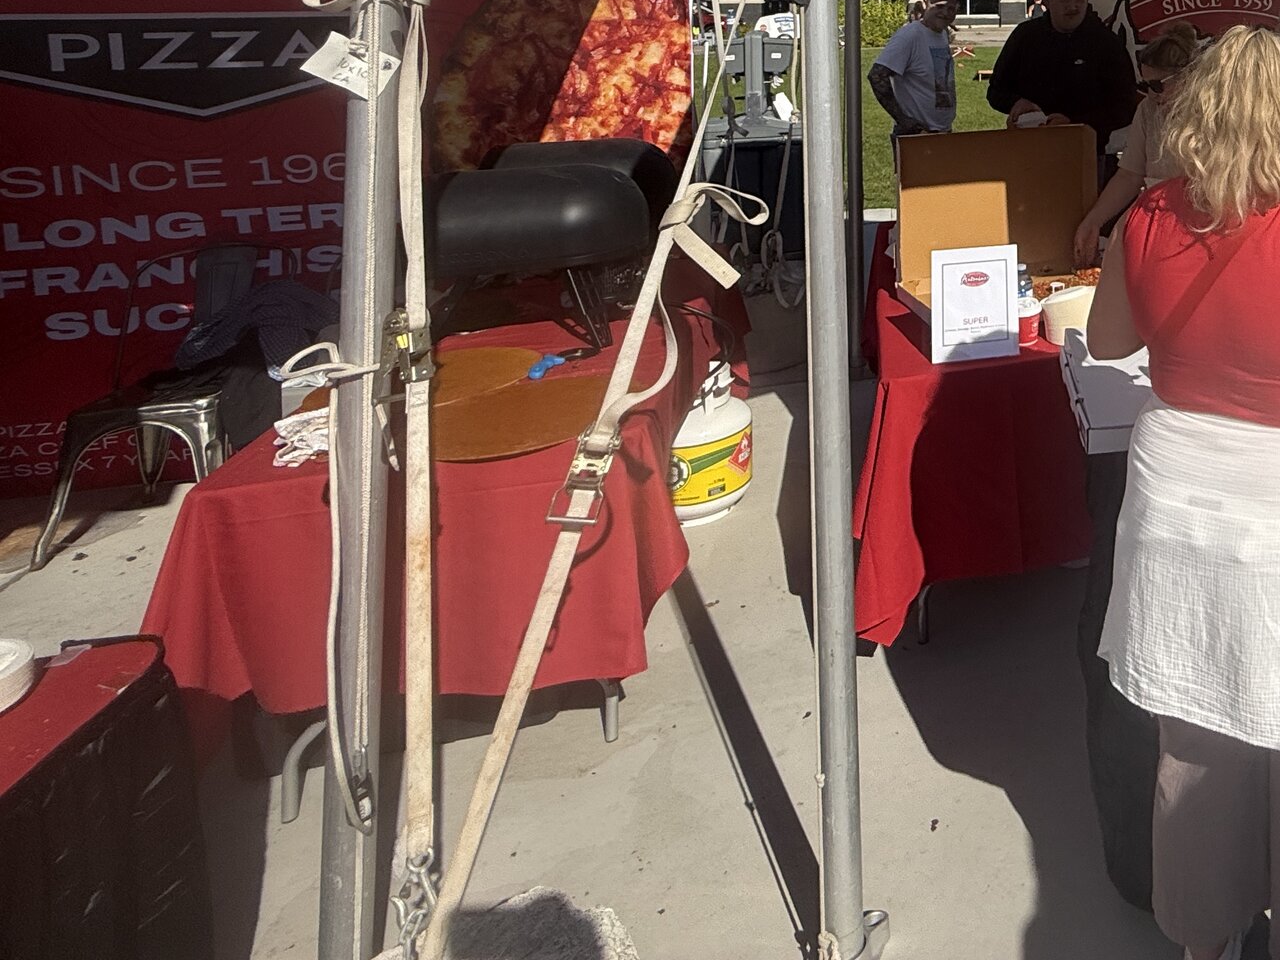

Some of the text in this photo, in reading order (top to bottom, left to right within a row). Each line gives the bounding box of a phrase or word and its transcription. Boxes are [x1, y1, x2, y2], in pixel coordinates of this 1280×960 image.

[47, 30, 322, 72] PIZZA
[0, 158, 227, 198] SINCE
[3, 202, 344, 252] LONG TER
[962, 316, 989, 326] SUPER
